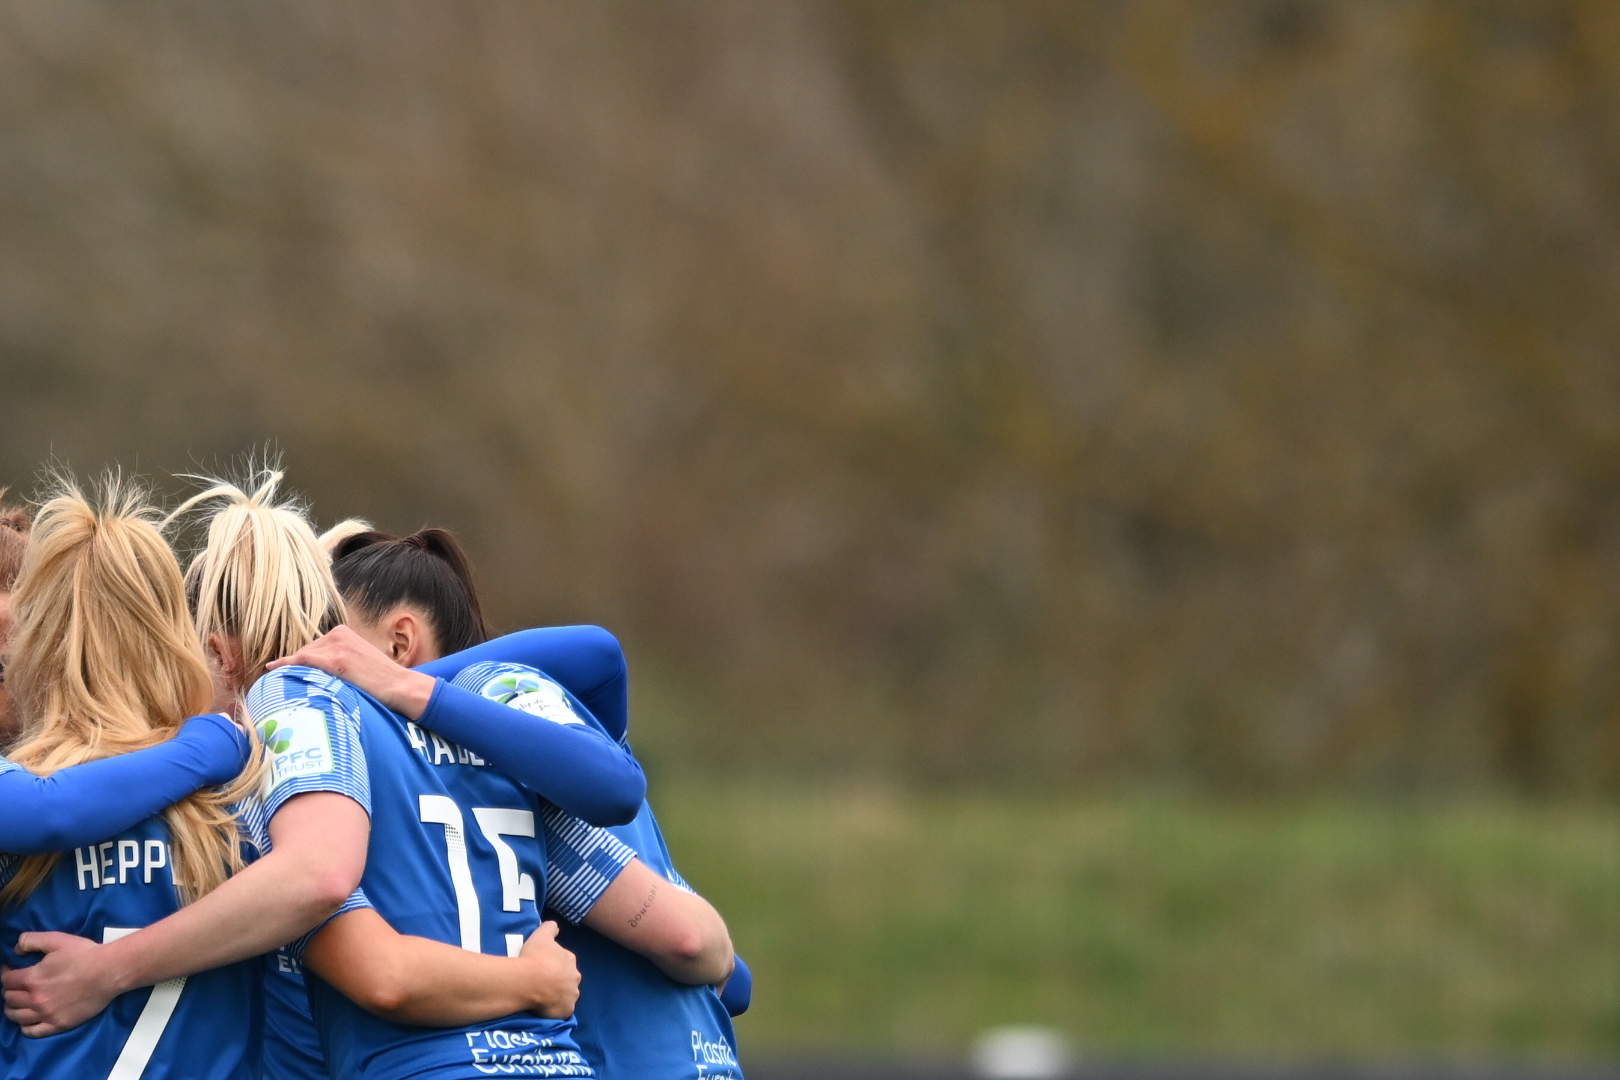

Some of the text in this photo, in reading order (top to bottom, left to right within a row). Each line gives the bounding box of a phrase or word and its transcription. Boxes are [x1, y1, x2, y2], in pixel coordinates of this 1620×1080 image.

[275, 747, 323, 771] PFC
[277, 760, 324, 778] TRUST
[418, 794, 541, 958] 15
[691, 1030, 737, 1067] Plastic
